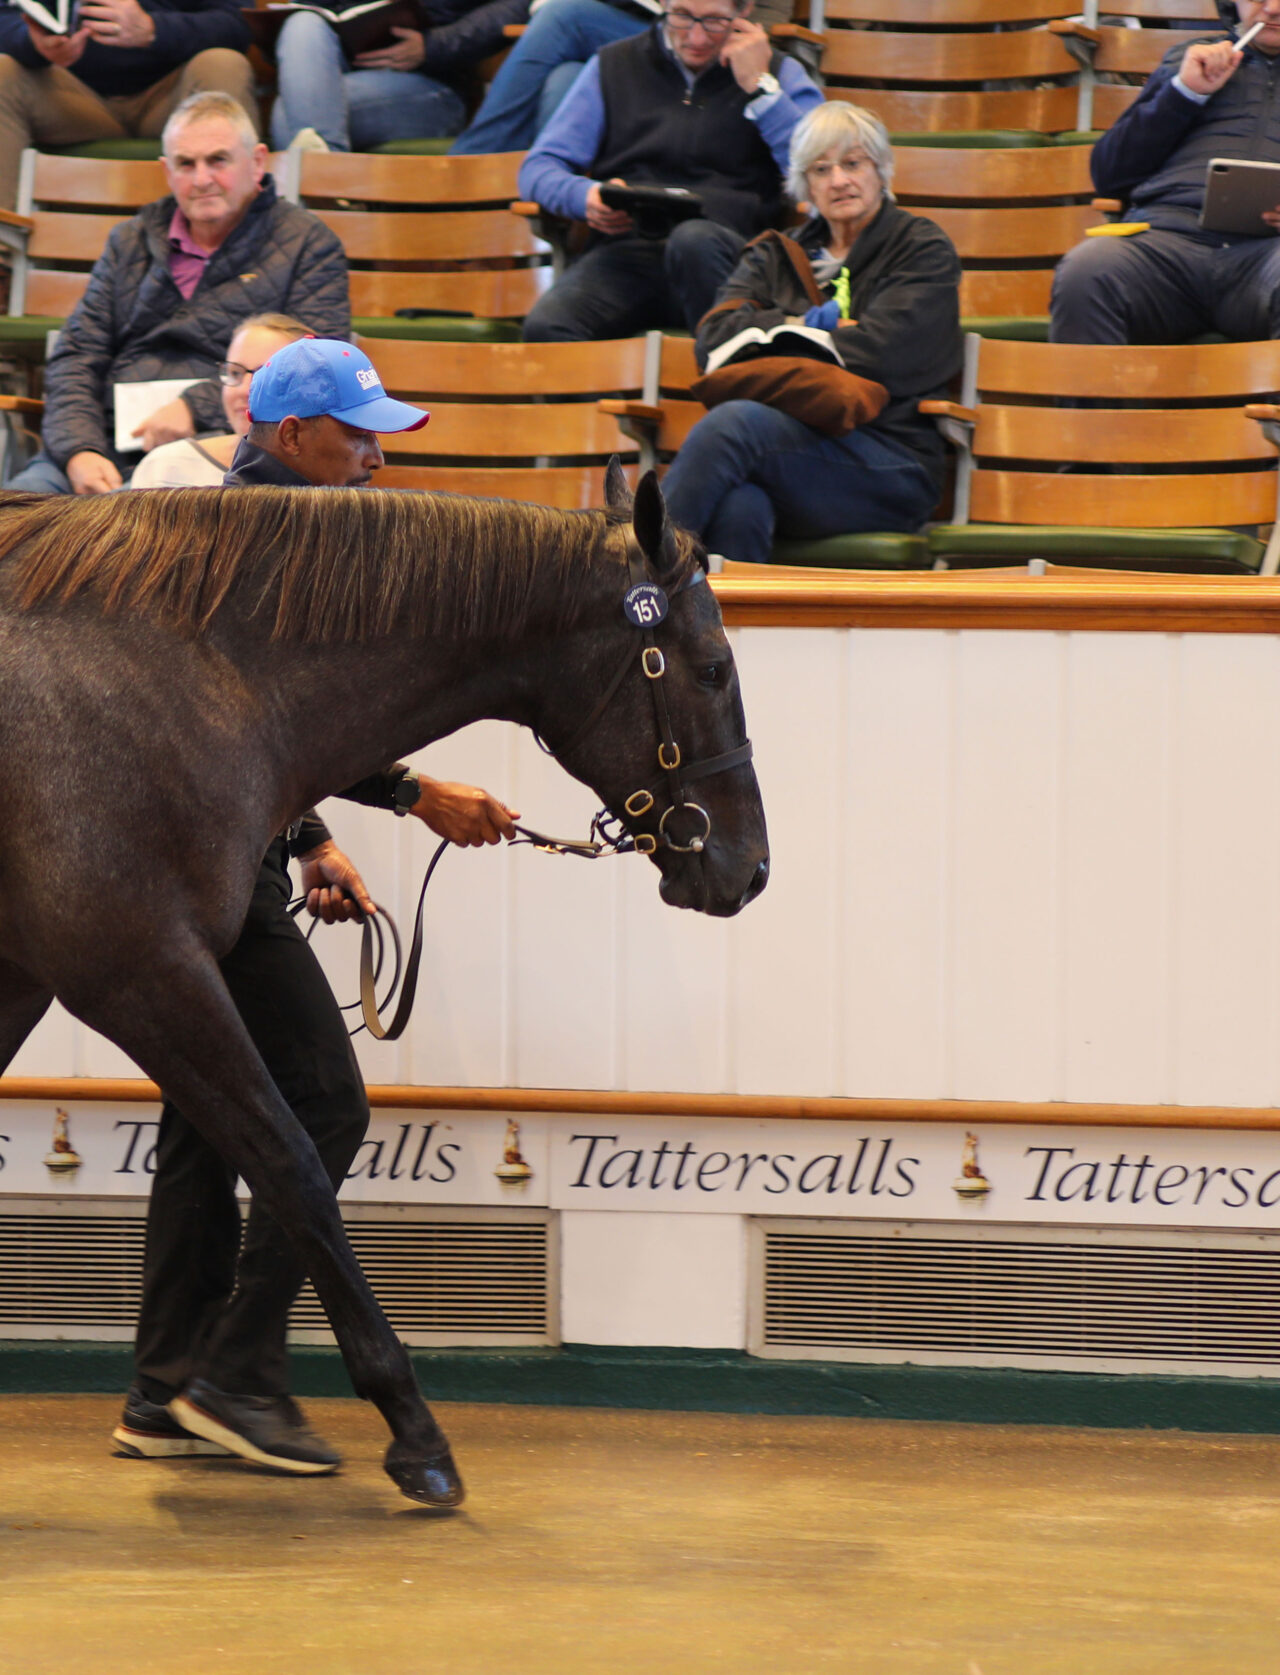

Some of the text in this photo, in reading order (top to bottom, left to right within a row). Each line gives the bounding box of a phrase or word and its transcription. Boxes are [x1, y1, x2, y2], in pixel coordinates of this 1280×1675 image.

[632, 595, 661, 624] 151
[113, 1119, 461, 1183] Taalls
[568, 1134, 921, 1198] Tattersalls
